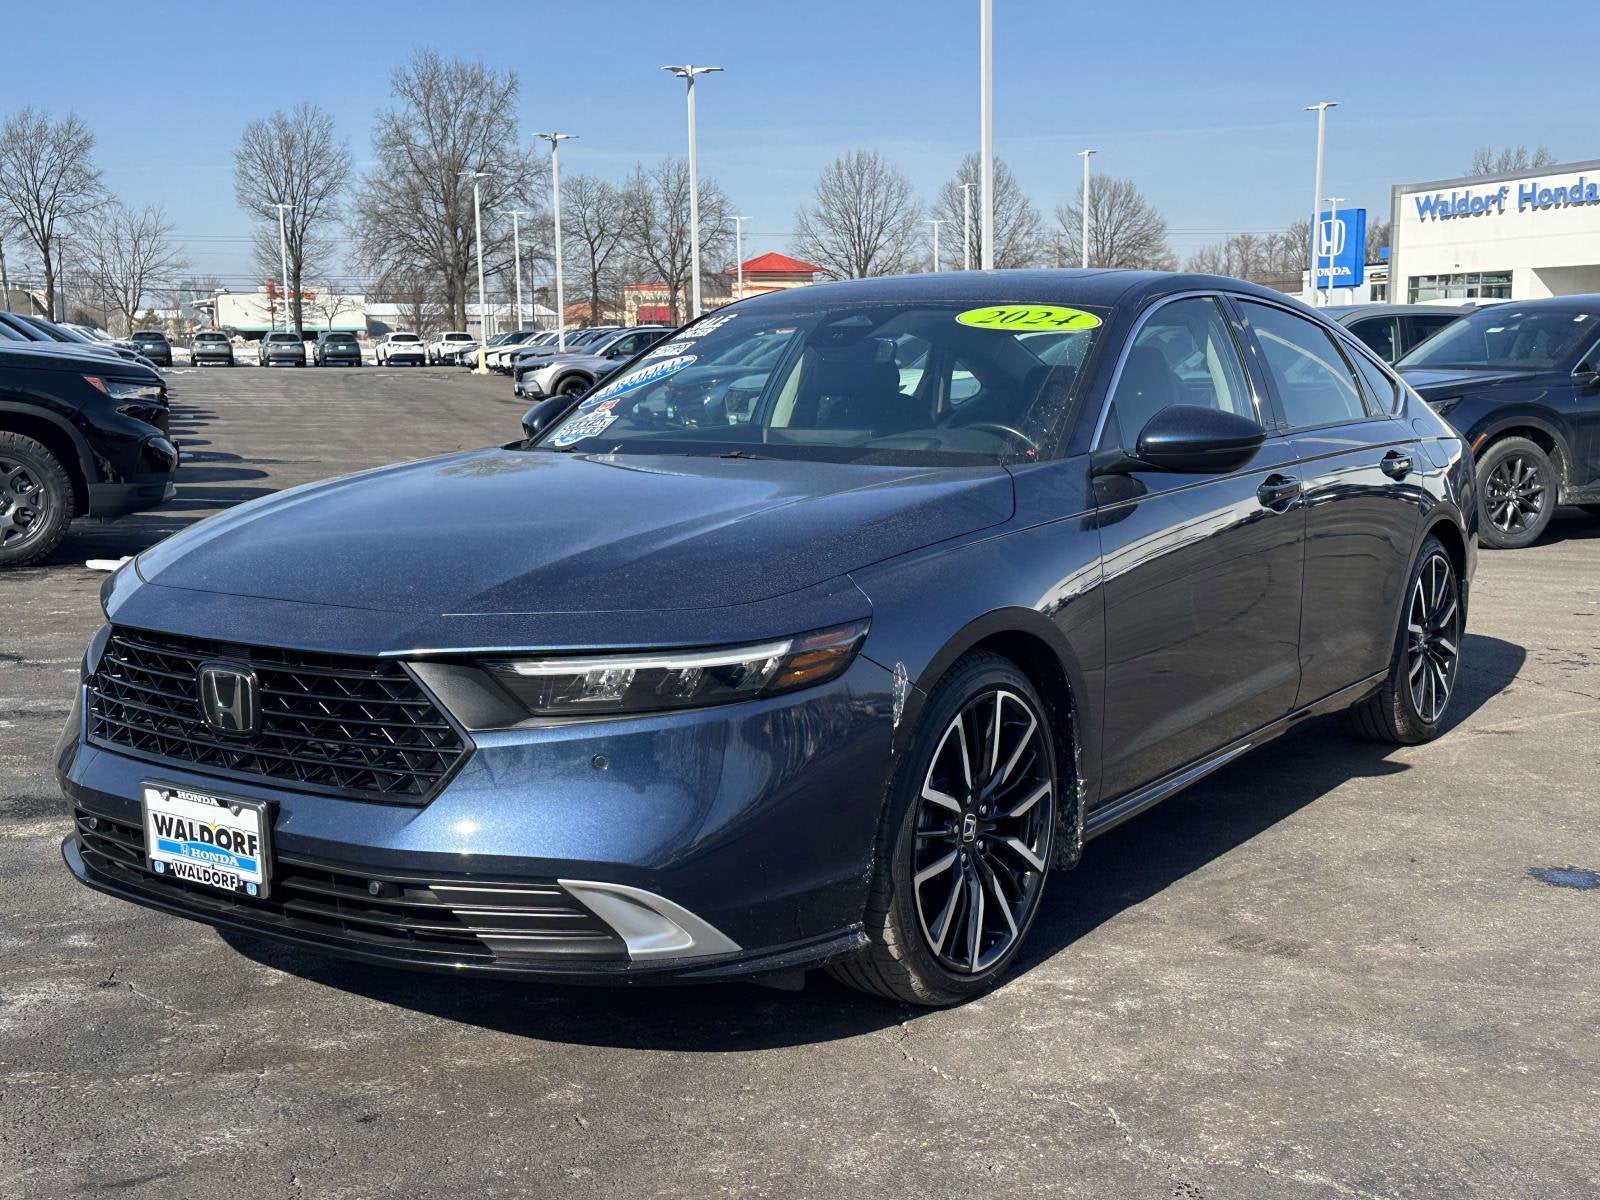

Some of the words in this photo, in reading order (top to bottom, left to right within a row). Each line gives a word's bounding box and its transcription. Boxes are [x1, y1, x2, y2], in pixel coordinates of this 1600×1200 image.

[1415, 185, 1509, 220] Waldorf
[1518, 176, 1599, 210] Honda
[1318, 266, 1352, 277] ONDA
[974, 310, 1082, 326] 2024
[176, 790, 220, 807] HONDA
[153, 813, 258, 857] WALDORF
[190, 847, 240, 867] HONDA
[174, 861, 238, 890] WALDORF
